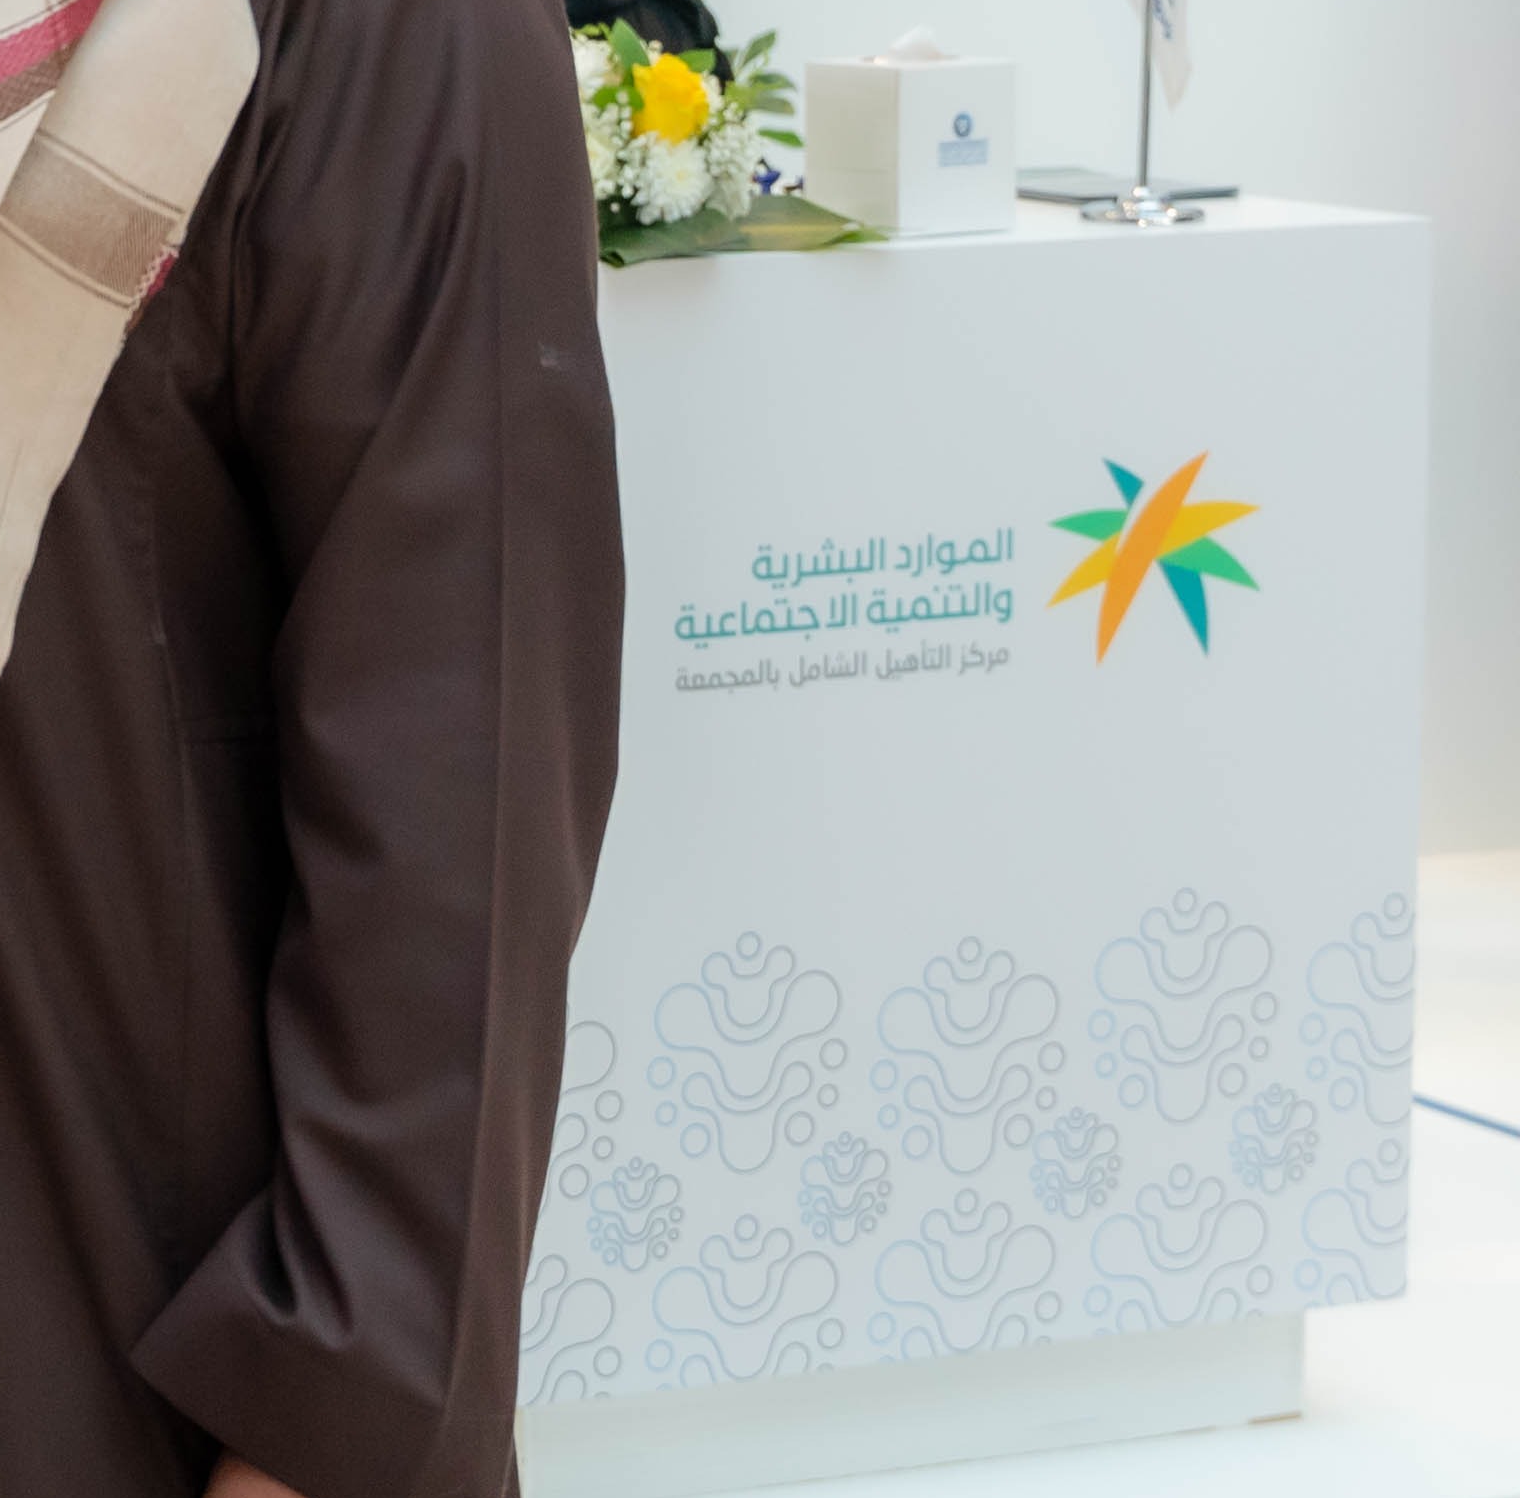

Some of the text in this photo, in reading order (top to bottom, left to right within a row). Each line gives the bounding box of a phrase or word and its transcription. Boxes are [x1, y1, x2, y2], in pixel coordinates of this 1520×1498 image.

[751, 527, 1015, 590] الموارد البشرية
[673, 582, 1015, 649] والتنمية الاجتماعية
[674, 639, 1011, 694] مركز التأهيل الشامل بالمجمعة
